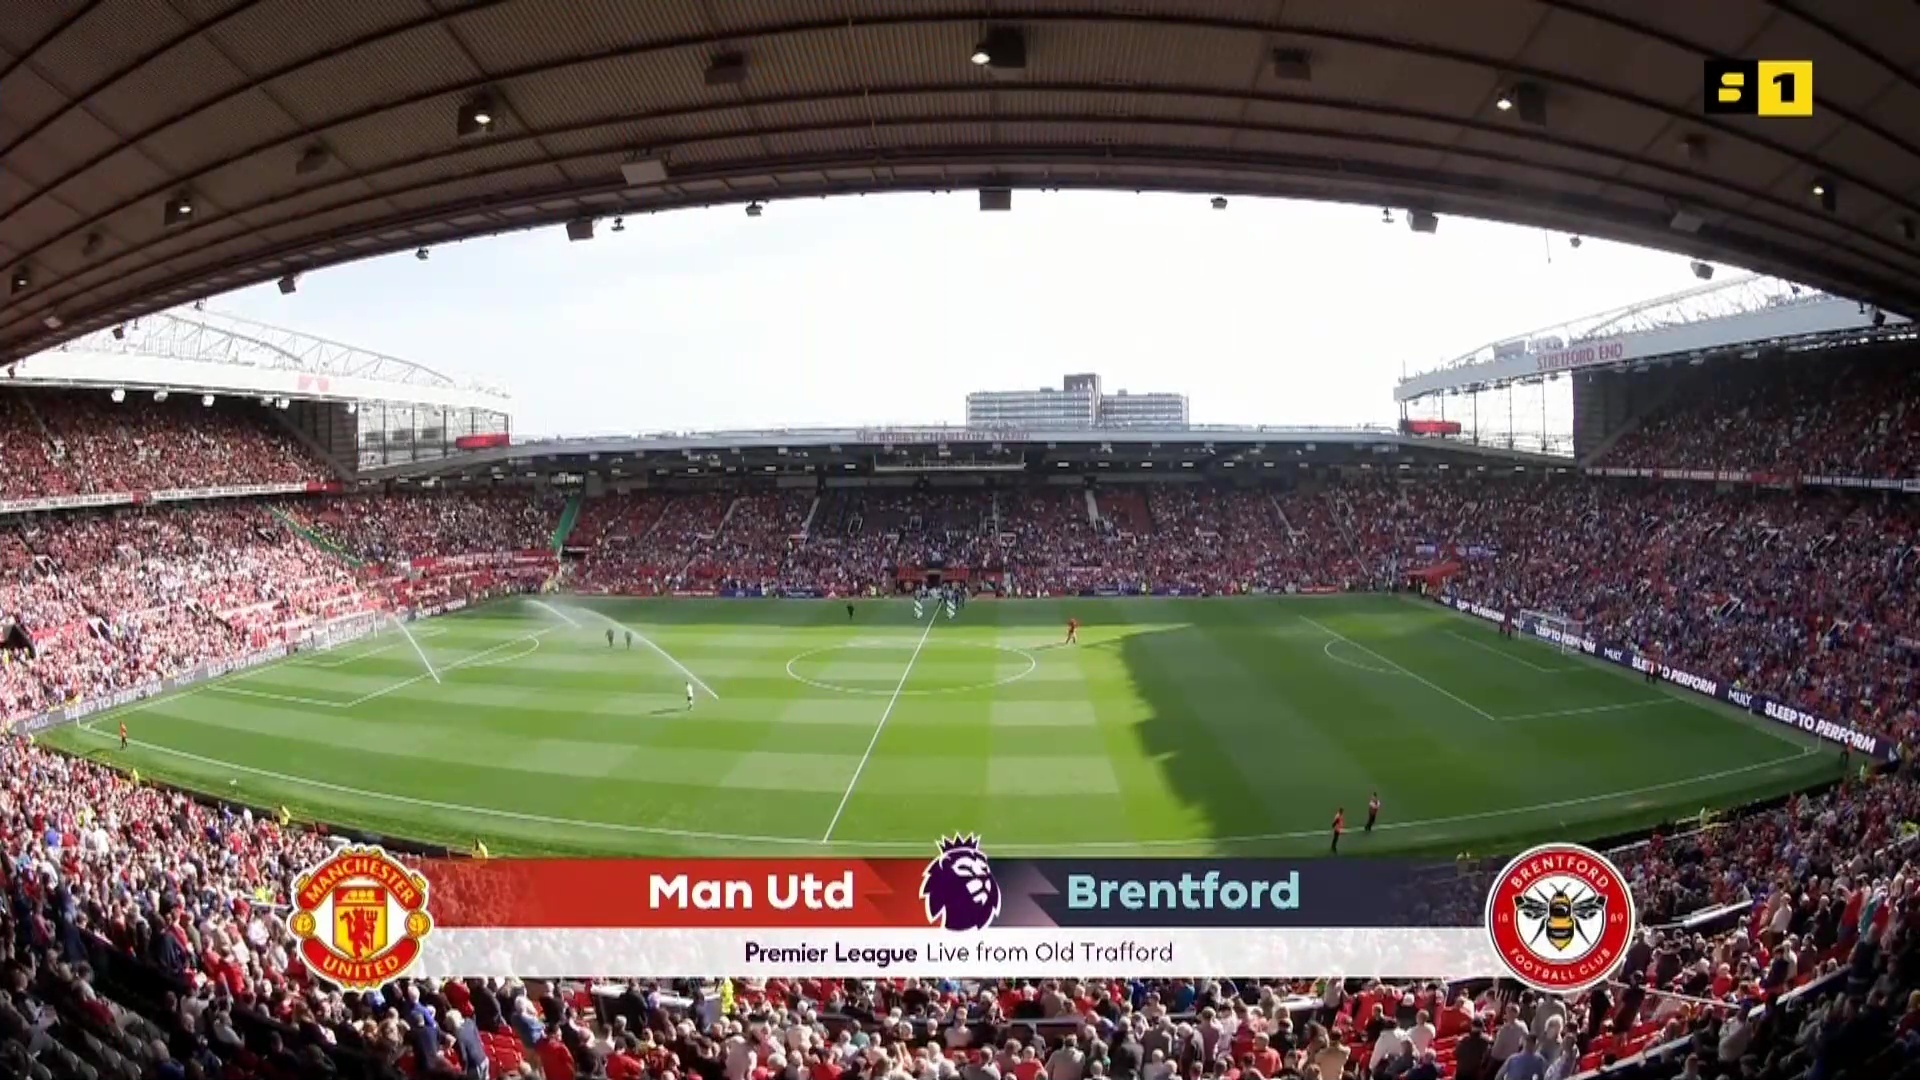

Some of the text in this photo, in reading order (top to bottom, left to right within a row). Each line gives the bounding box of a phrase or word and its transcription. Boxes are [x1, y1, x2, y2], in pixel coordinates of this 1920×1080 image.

[1537, 343, 1623, 371] STRETFORD END
[1670, 669, 1717, 696] PERFORM
[1765, 701, 1877, 754] SLEEP TO PERFORM
